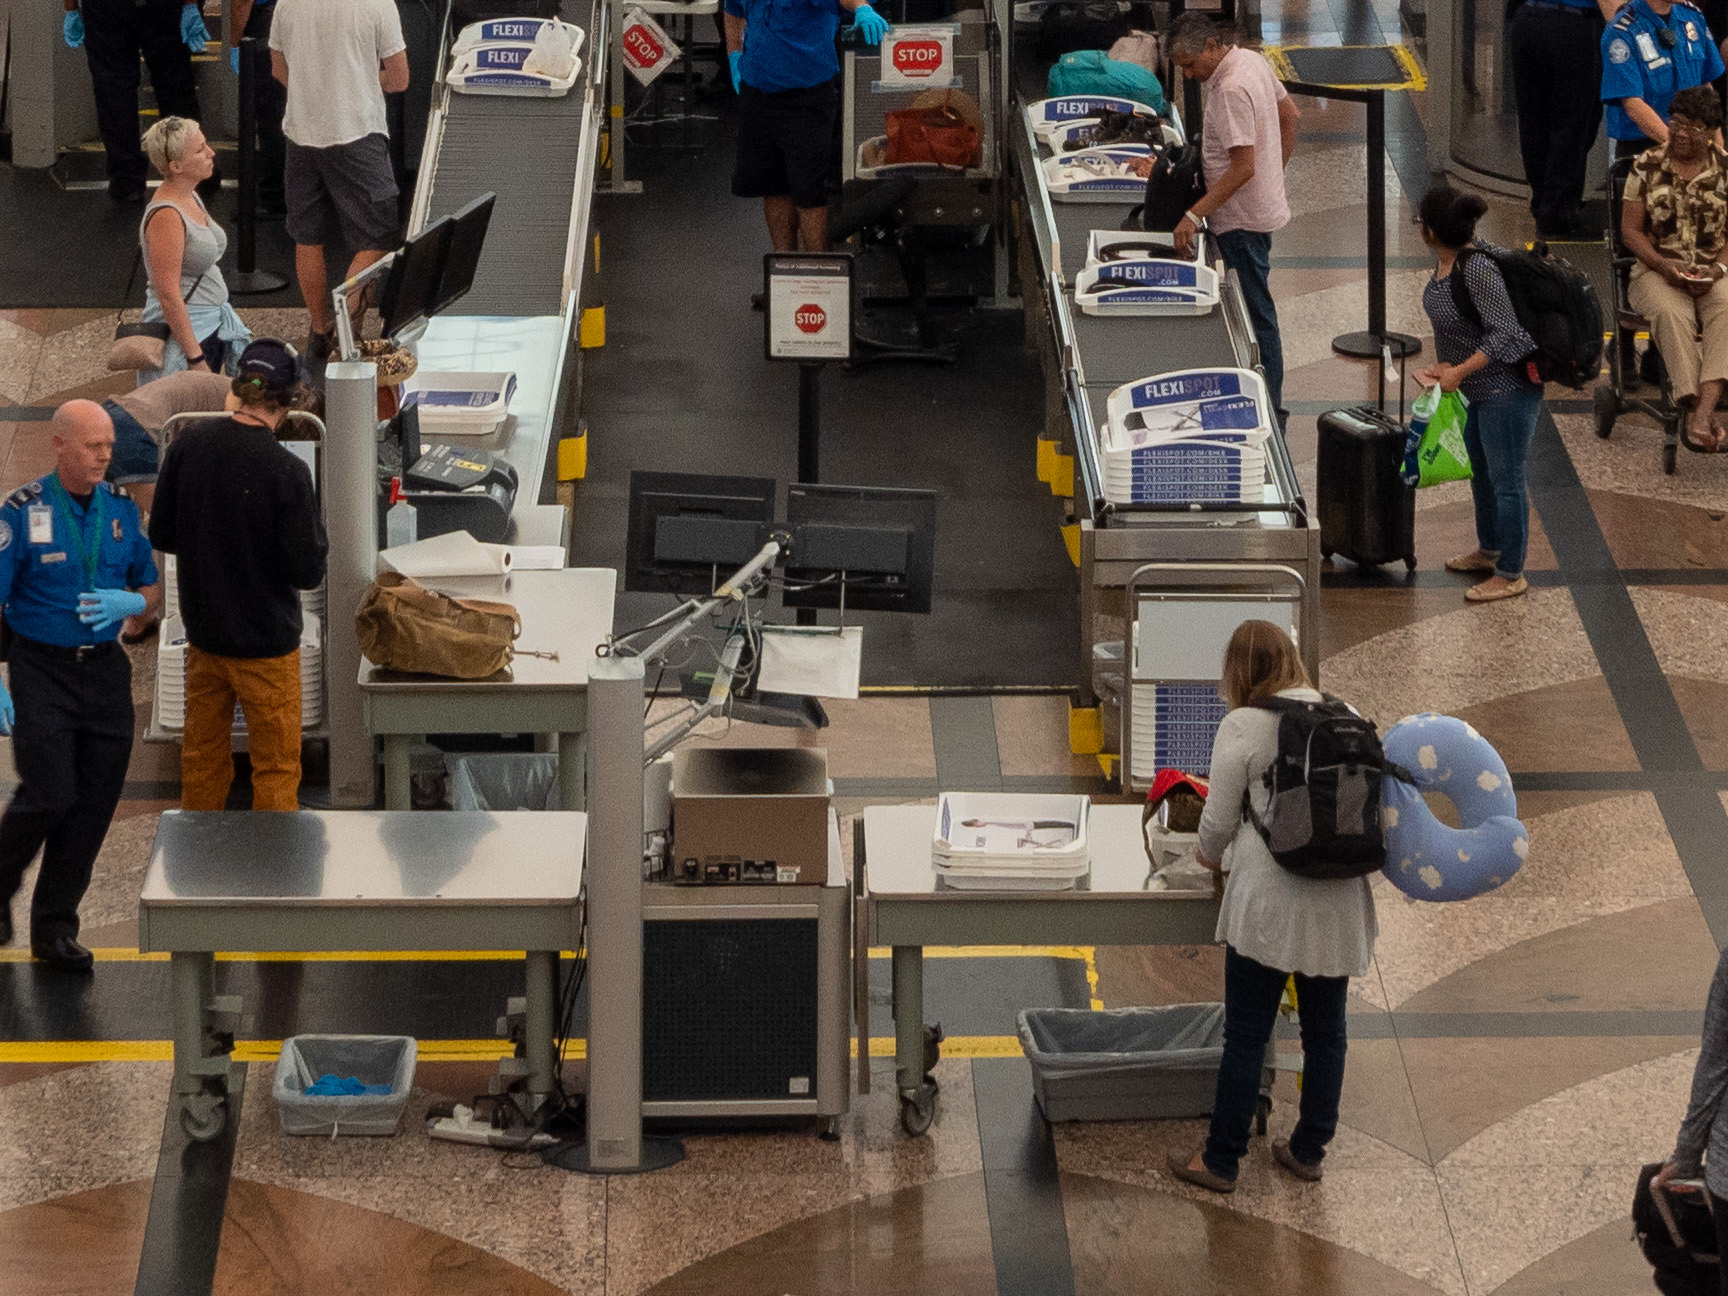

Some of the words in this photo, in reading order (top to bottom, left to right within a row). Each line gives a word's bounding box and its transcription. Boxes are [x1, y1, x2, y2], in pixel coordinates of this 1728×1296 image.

[628, 31, 657, 61] STOP
[898, 49, 937, 62] STOP
[1111, 266, 1179, 280] FLEXISPOT
[1157, 278, 1179, 286] .COM
[796, 313, 825, 325] STOP
[1145, 376, 1220, 398] FLEXISPOT
[1198, 389, 1221, 398] .COM
